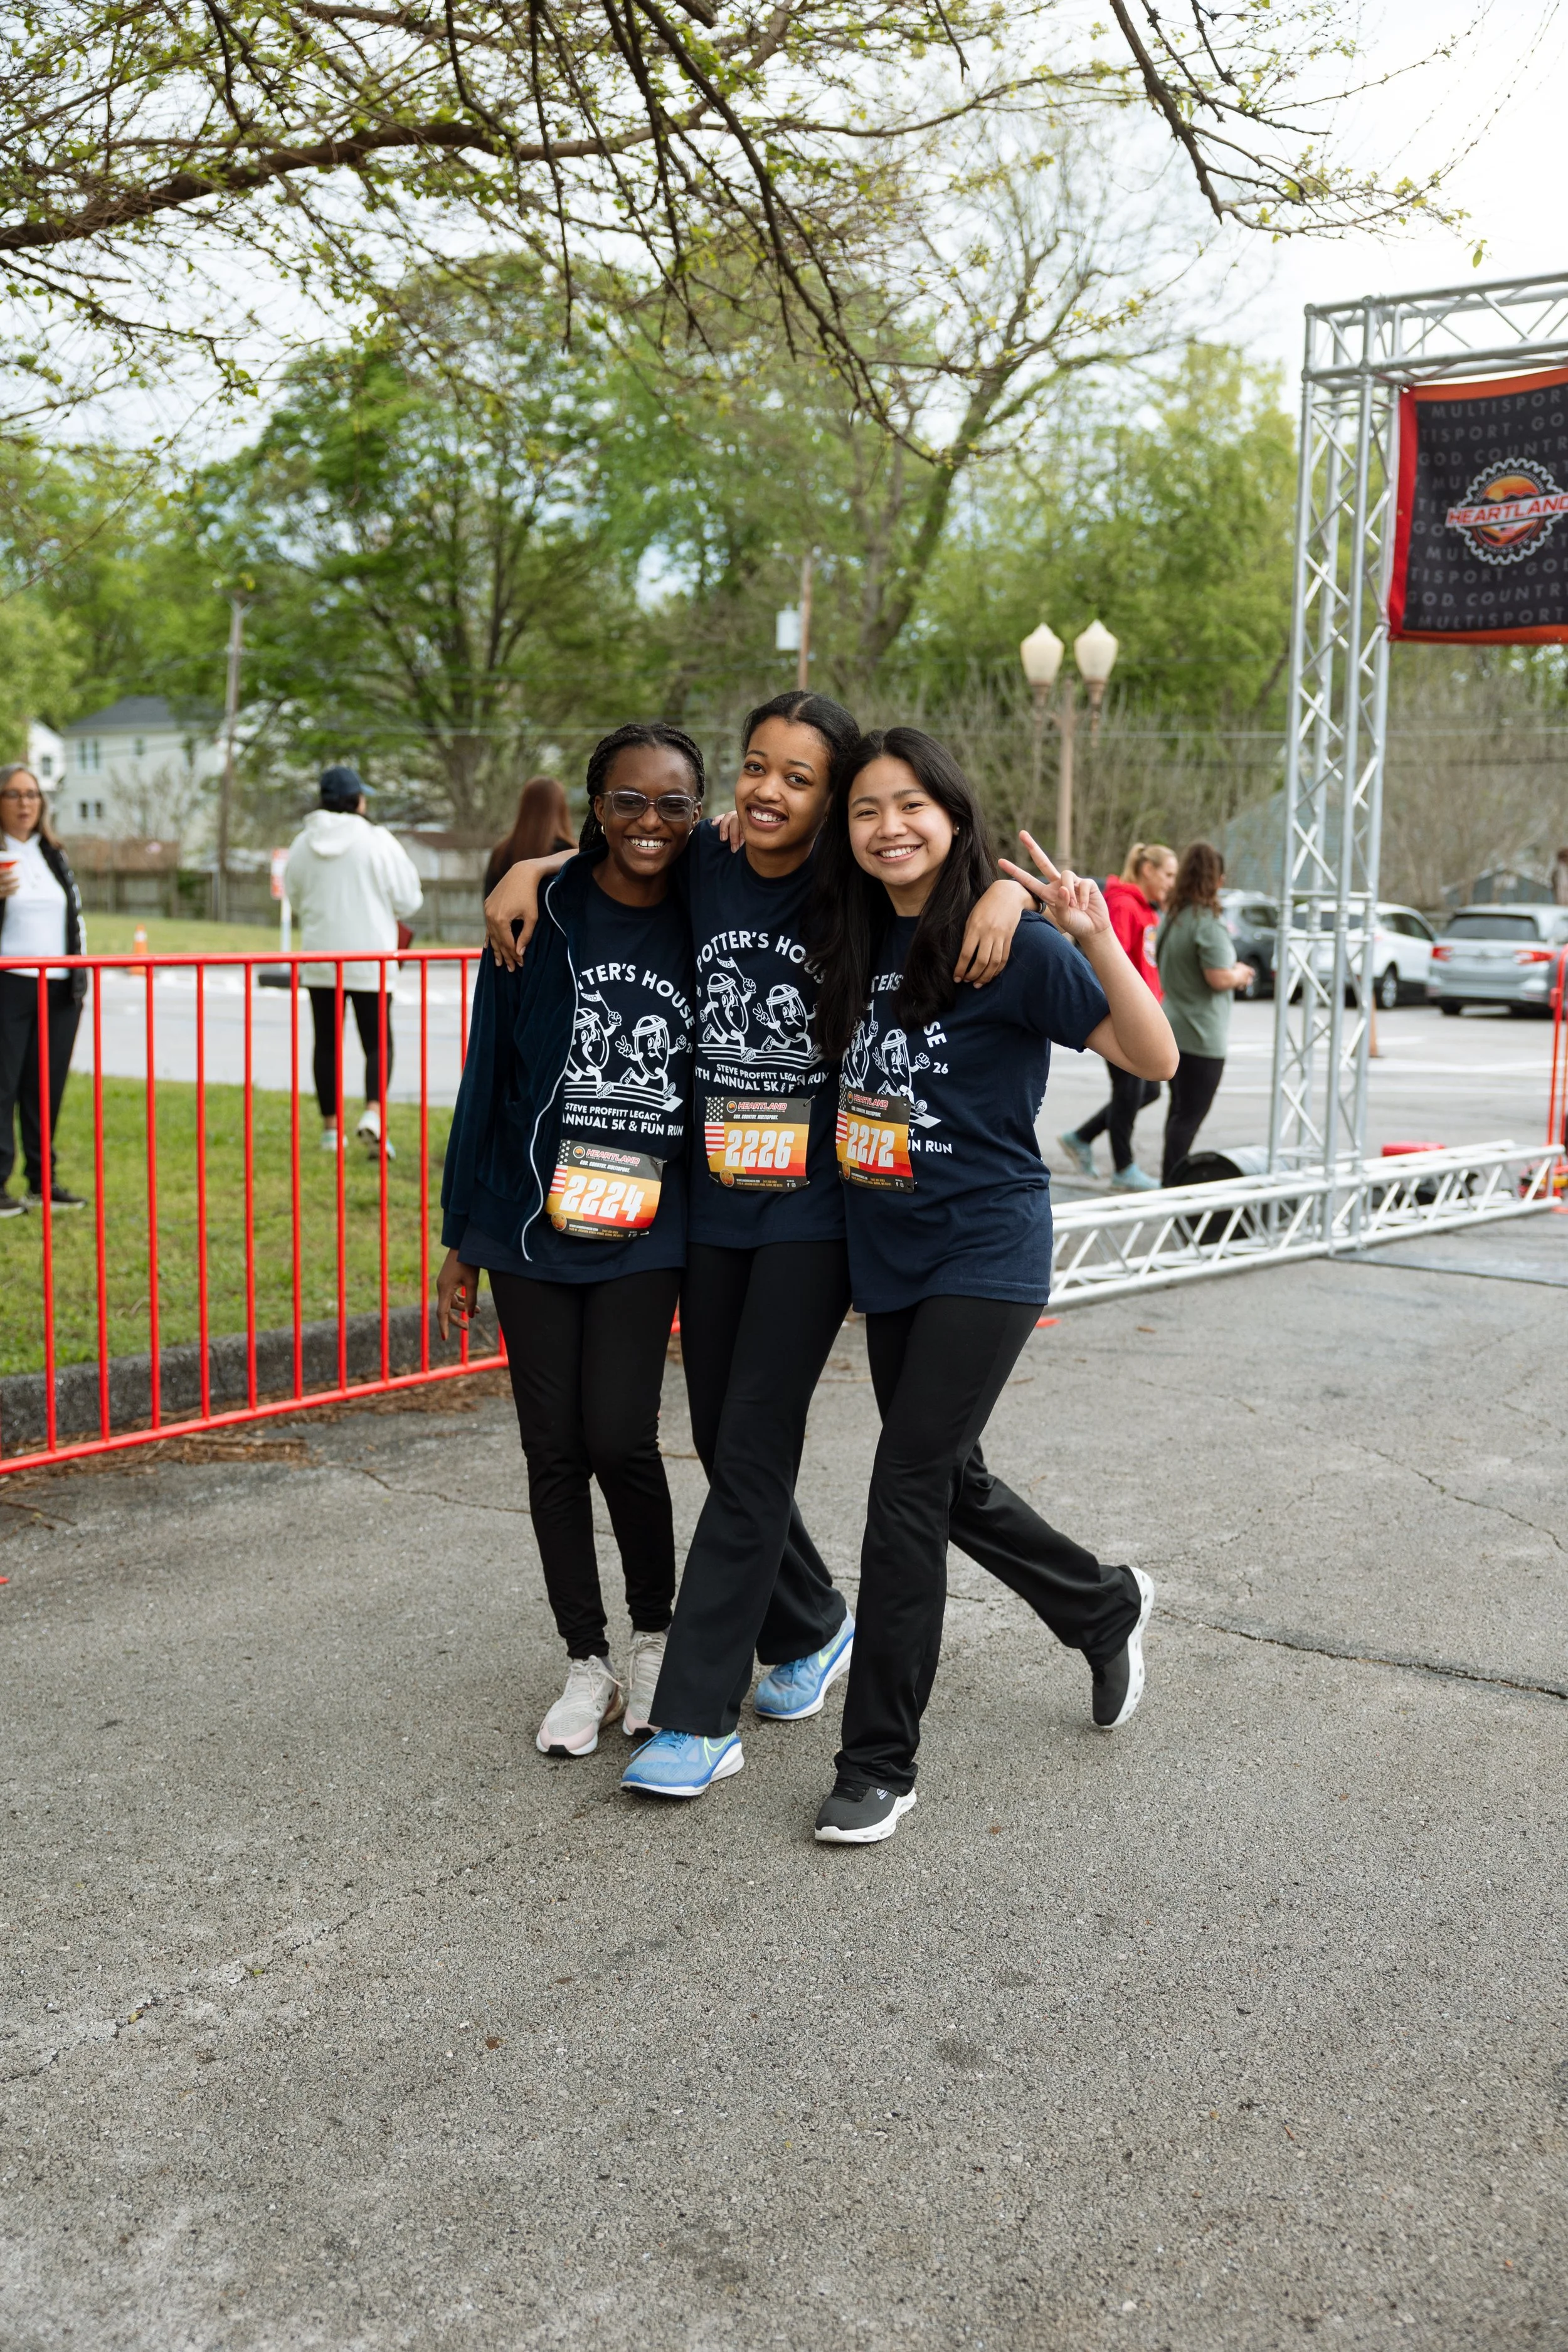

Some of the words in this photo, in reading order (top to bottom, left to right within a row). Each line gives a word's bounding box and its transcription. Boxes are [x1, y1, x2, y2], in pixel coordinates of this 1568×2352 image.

[1431, 389, 1568, 418] MULTISPOR
[1448, 495, 1568, 524] HEARTLAND
[1466, 582, 1568, 608] COUNTR
[697, 930, 769, 973] POTTER'S
[642, 970, 696, 1030] HOUSE
[716, 1064, 738, 1076] STEVE
[739, 1069, 778, 1080] PROFFITT
[933, 1062, 948, 1074] 26
[713, 1073, 760, 1091] ANNUAL
[763, 1081, 780, 1093] 5K
[807, 1071, 830, 1085] RUN
[738, 1101, 787, 1110] HEARTLAND
[854, 1093, 889, 1108] HEARTLAND
[564, 1103, 587, 1114] STEVE
[590, 1106, 628, 1118] PROFFITT
[629, 1110, 661, 1121] LEGACY
[612, 1119, 626, 1130] 5K
[628, 1121, 638, 1132] &
[640, 1121, 665, 1135] FUN
[667, 1125, 684, 1136] RUN
[724, 1130, 795, 1169] 2226
[847, 1121, 895, 1168] 2272
[926, 1140, 953, 1154] RUN
[585, 1148, 640, 1165] HEARTLAND
[559, 1175, 645, 1222] 2224
